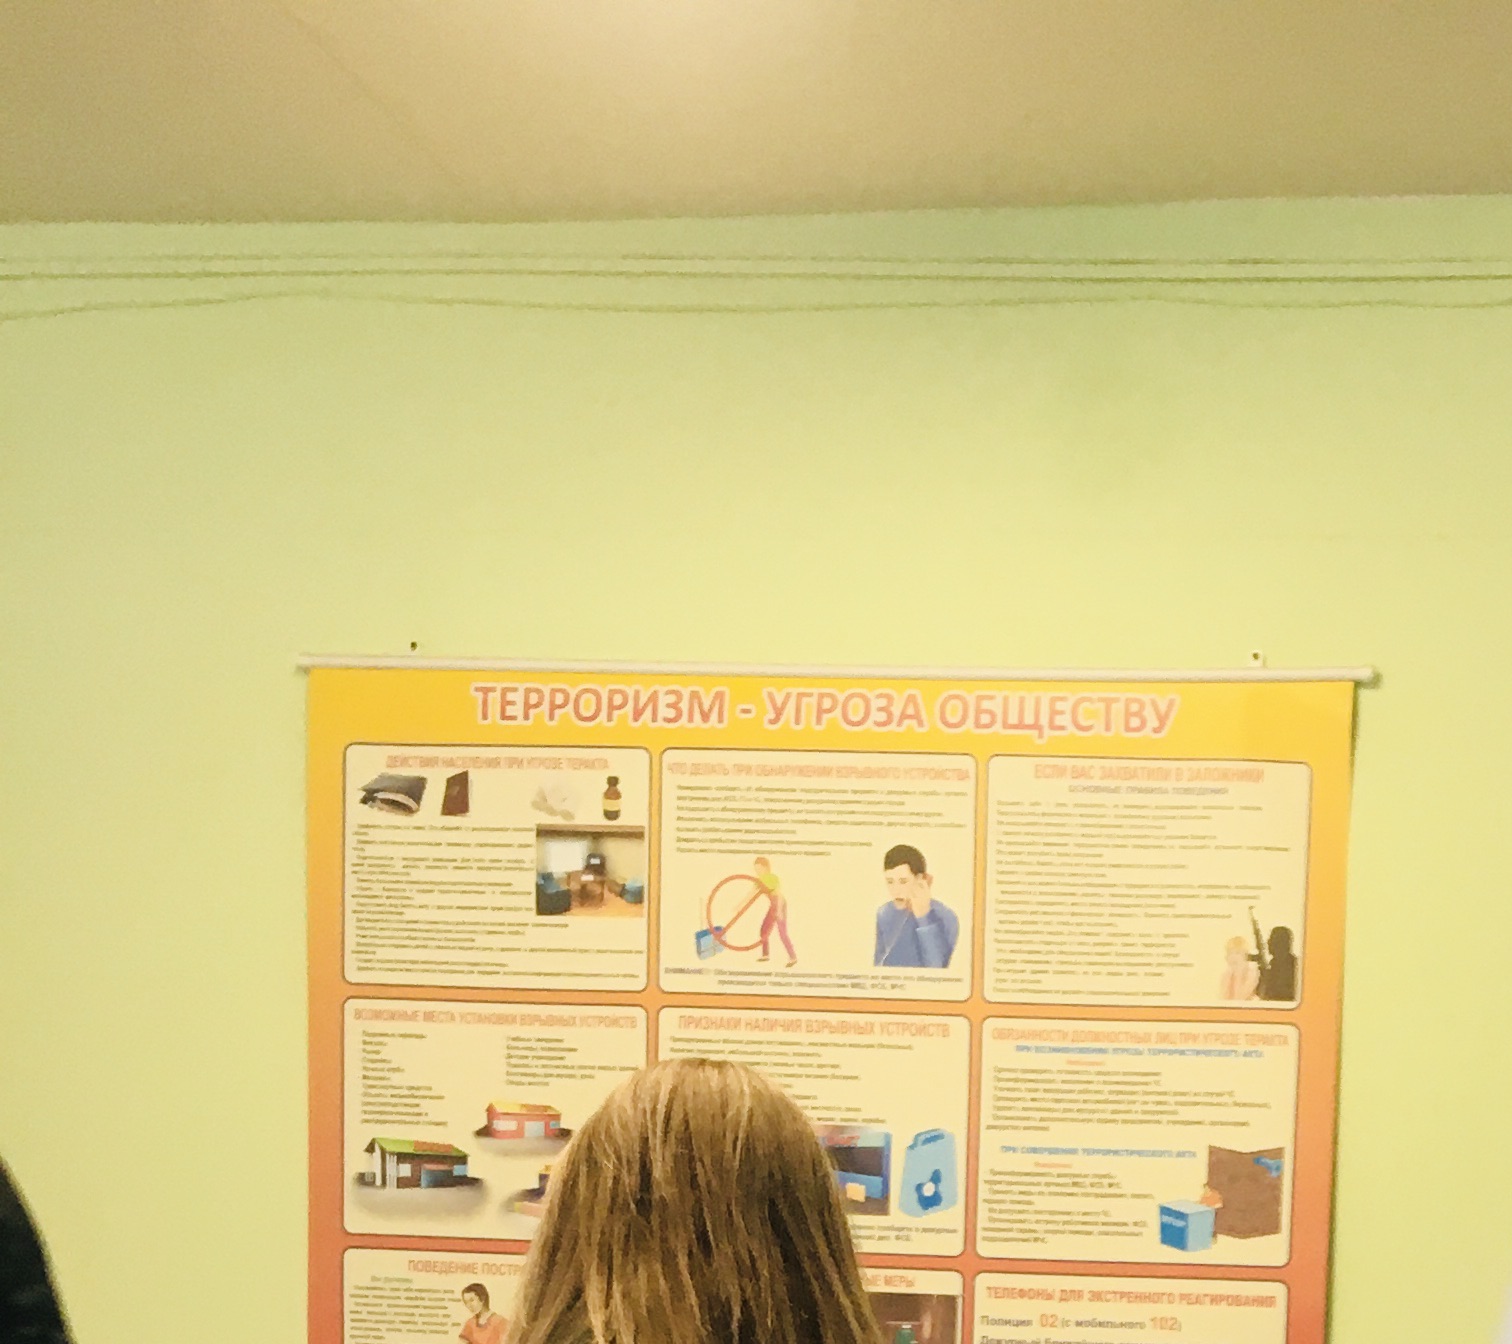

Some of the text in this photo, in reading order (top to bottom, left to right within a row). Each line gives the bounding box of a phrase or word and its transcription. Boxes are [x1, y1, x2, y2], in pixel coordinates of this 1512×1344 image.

[473, 686, 726, 725] ТЕРРОРИЗМ
[766, 690, 925, 730] УГРОЗА
[938, 693, 1177, 740] ОБЩЕСТВУ
[1039, 1313, 1059, 1328] 02
